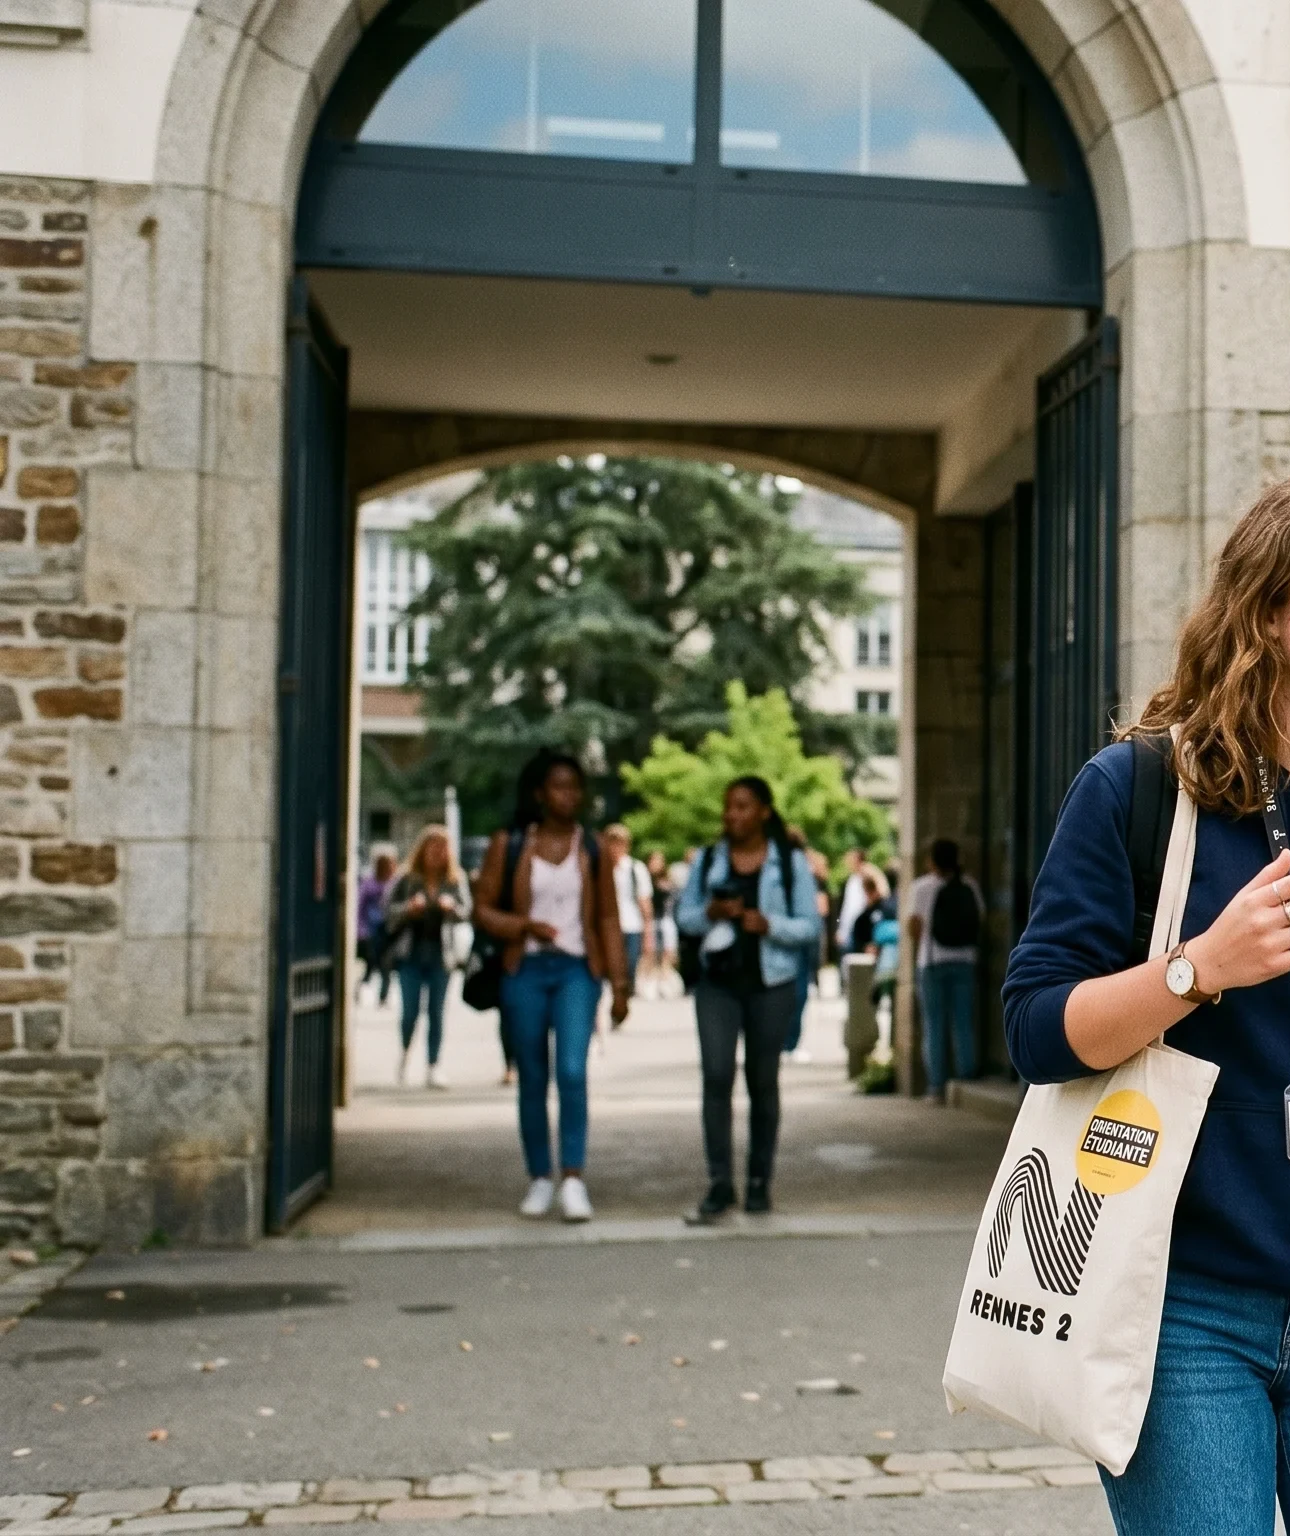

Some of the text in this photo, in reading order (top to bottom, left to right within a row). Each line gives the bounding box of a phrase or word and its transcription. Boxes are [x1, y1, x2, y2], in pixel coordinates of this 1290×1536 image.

[1083, 1131, 1150, 1165] ÉTUDIANTE
[1090, 1118, 1156, 1147] ORIENTATION
[969, 1288, 1073, 1342] RENNES 2
